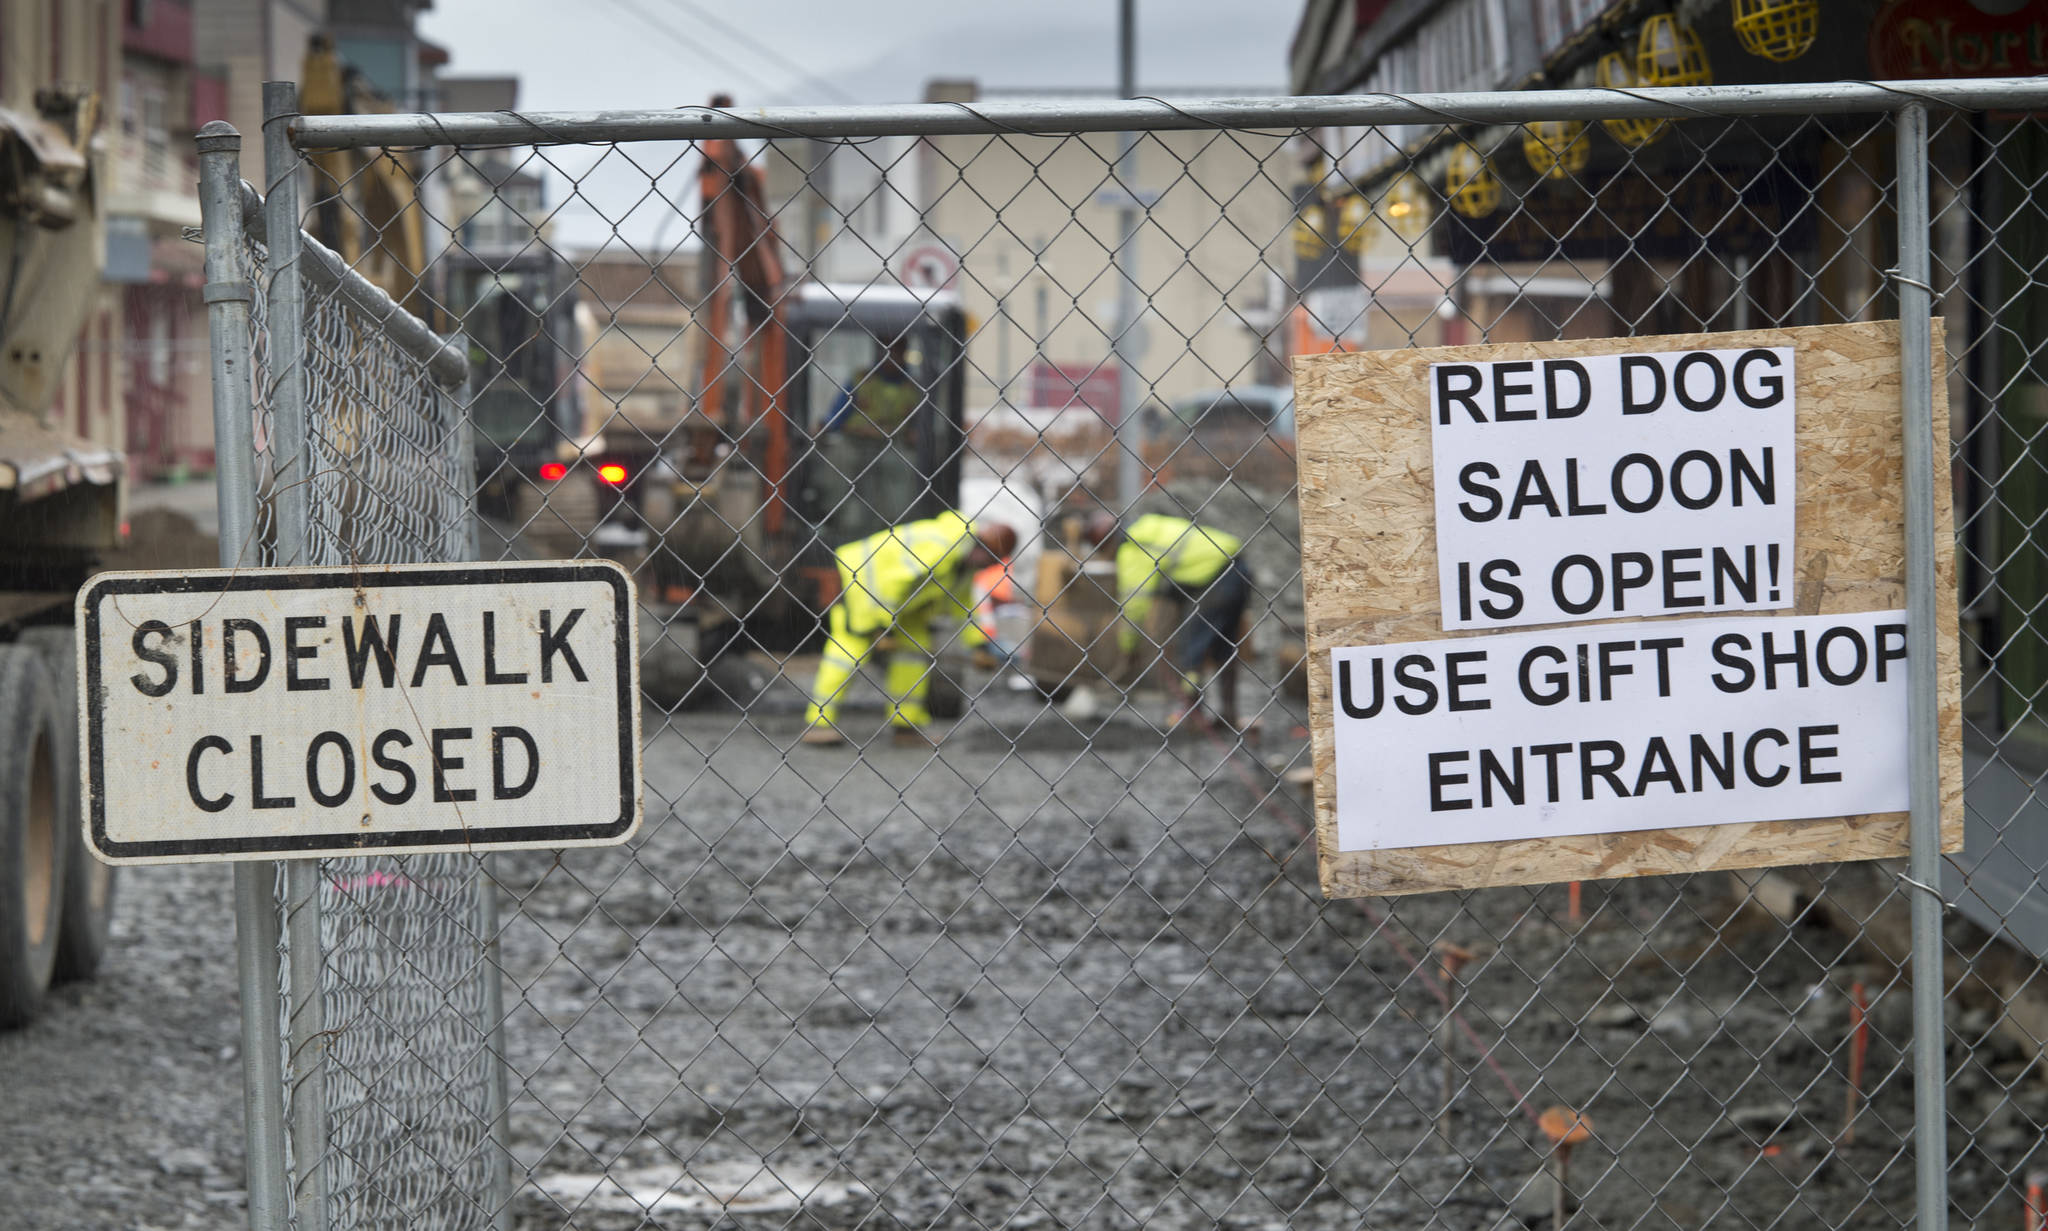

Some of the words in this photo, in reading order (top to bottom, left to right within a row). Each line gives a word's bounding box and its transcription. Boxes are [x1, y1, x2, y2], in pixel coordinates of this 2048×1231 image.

[1437, 360, 1591, 424] RED
[1621, 349, 1783, 414] DOG
[1459, 447, 1775, 522] SALOON
[1459, 560, 1523, 620] IS
[1552, 544, 1779, 614] OPEN!
[131, 609, 588, 697] SIDEWALK
[1340, 651, 1490, 719] USE
[1519, 638, 1683, 706] GIFT
[1712, 624, 1907, 693] SHOP
[187, 727, 539, 812] CLOSED
[1429, 725, 1841, 811] ENTRANCE
